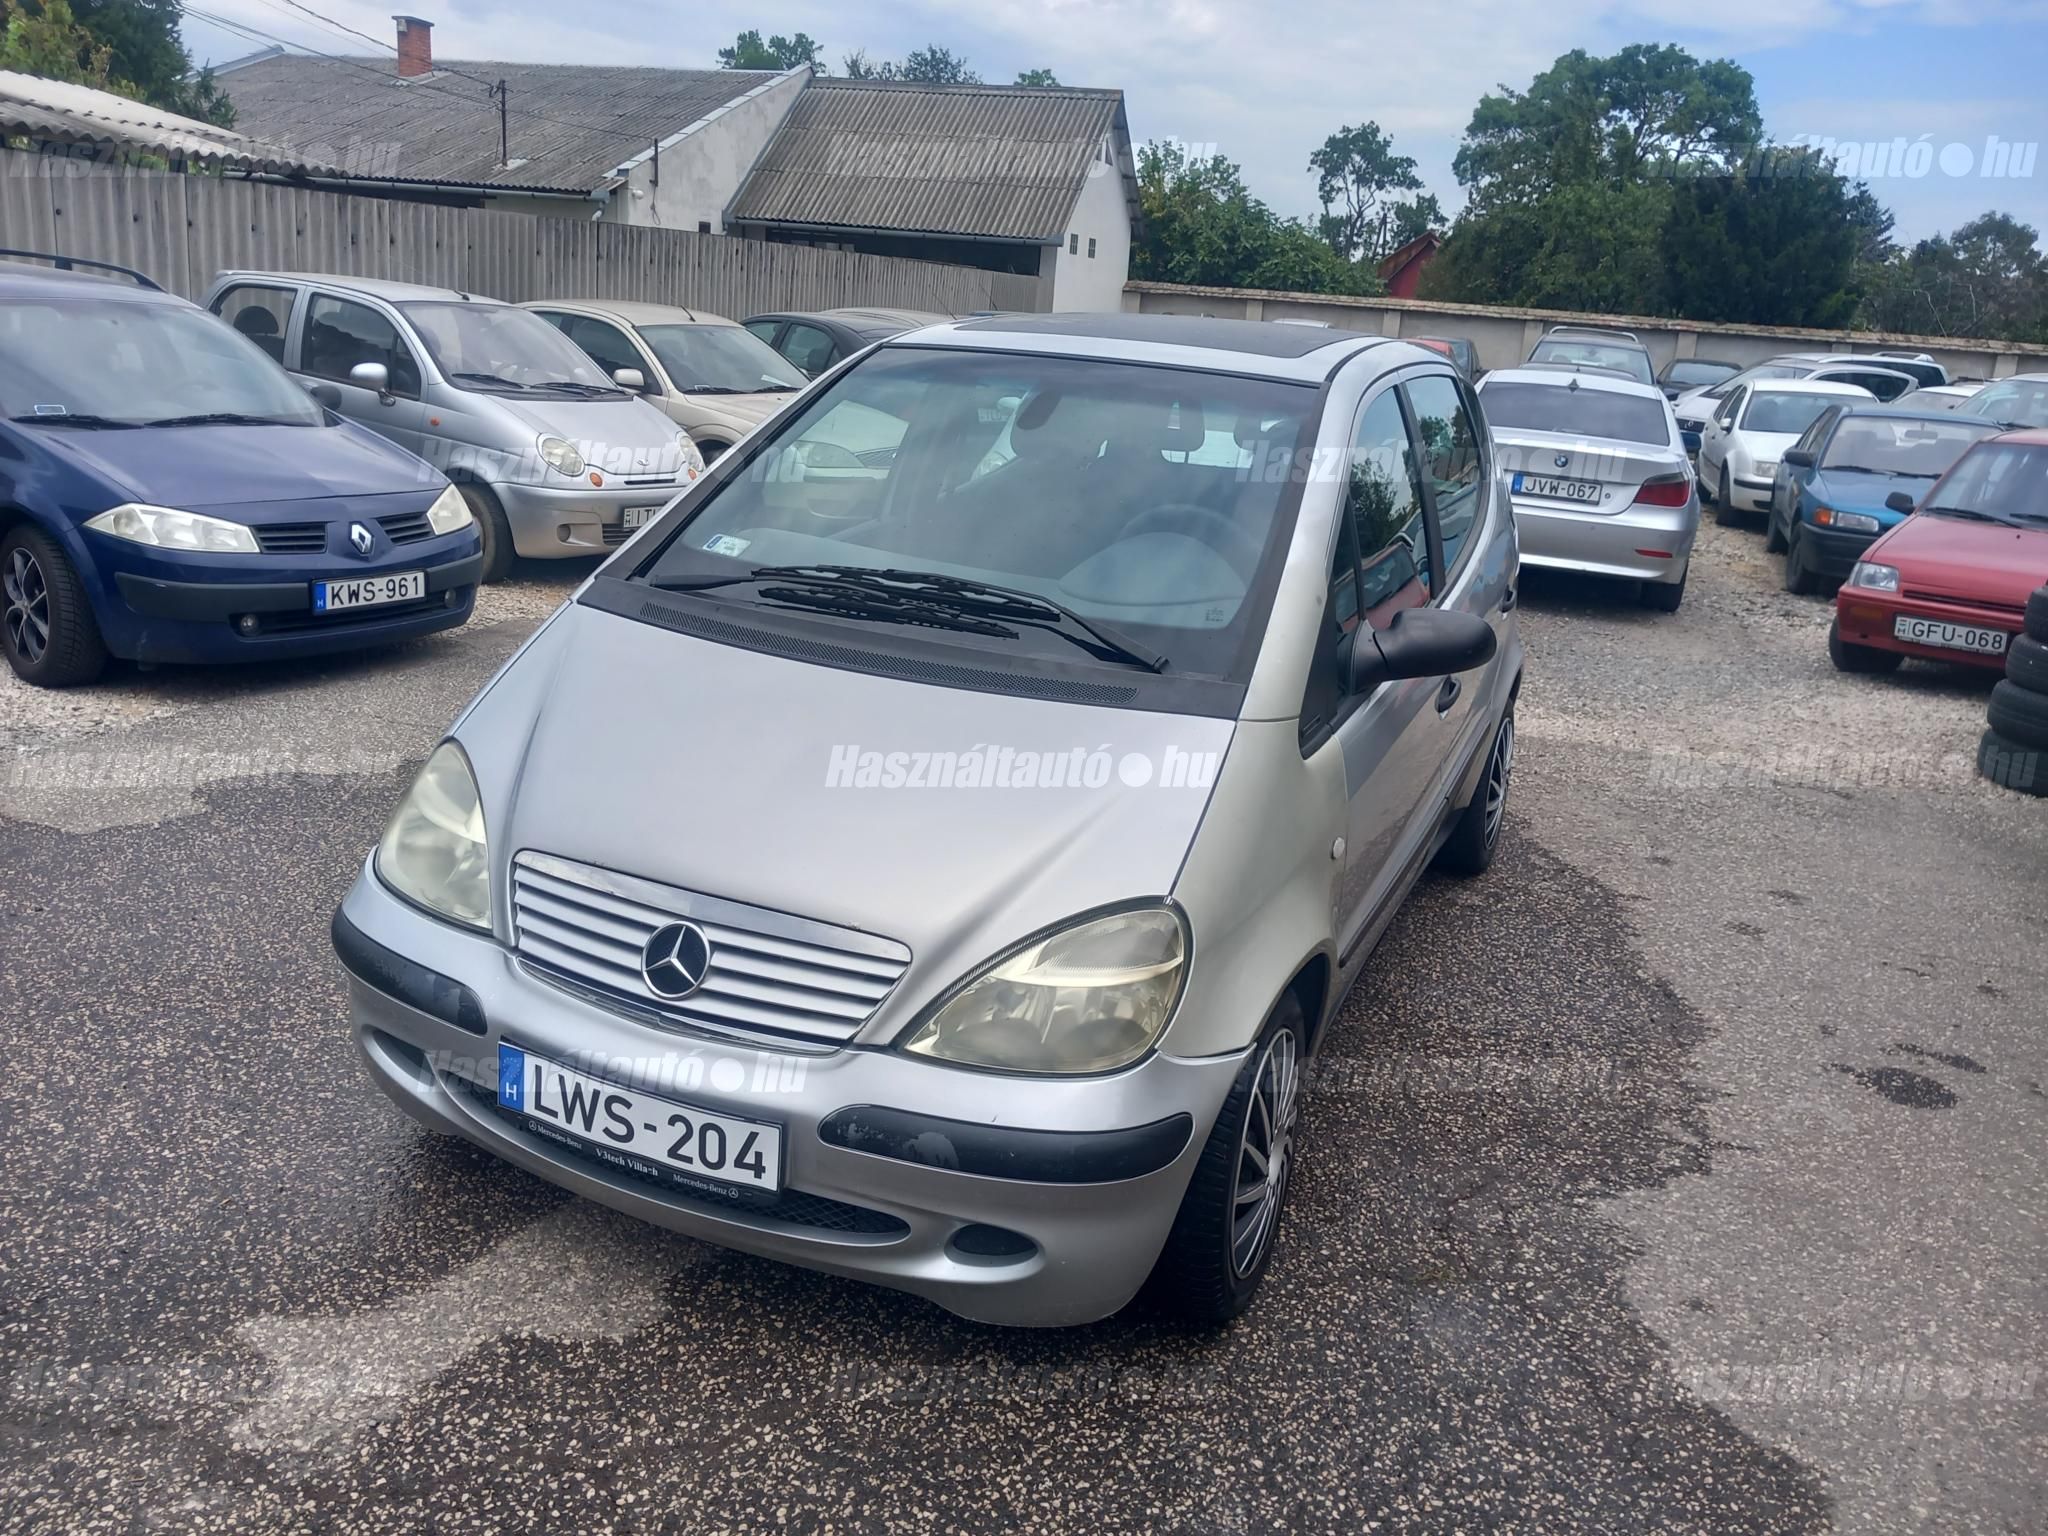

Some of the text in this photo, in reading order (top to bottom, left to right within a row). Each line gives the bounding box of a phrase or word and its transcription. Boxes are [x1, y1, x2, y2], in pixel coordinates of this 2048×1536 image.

[1525, 478, 1597, 499] JVW-067
[331, 576, 418, 607] KWS-961
[1912, 621, 2003, 650] GFU-068
[505, 1064, 766, 1180] H LWS-204
[672, 1173, 728, 1195] Mercedes-Benz
